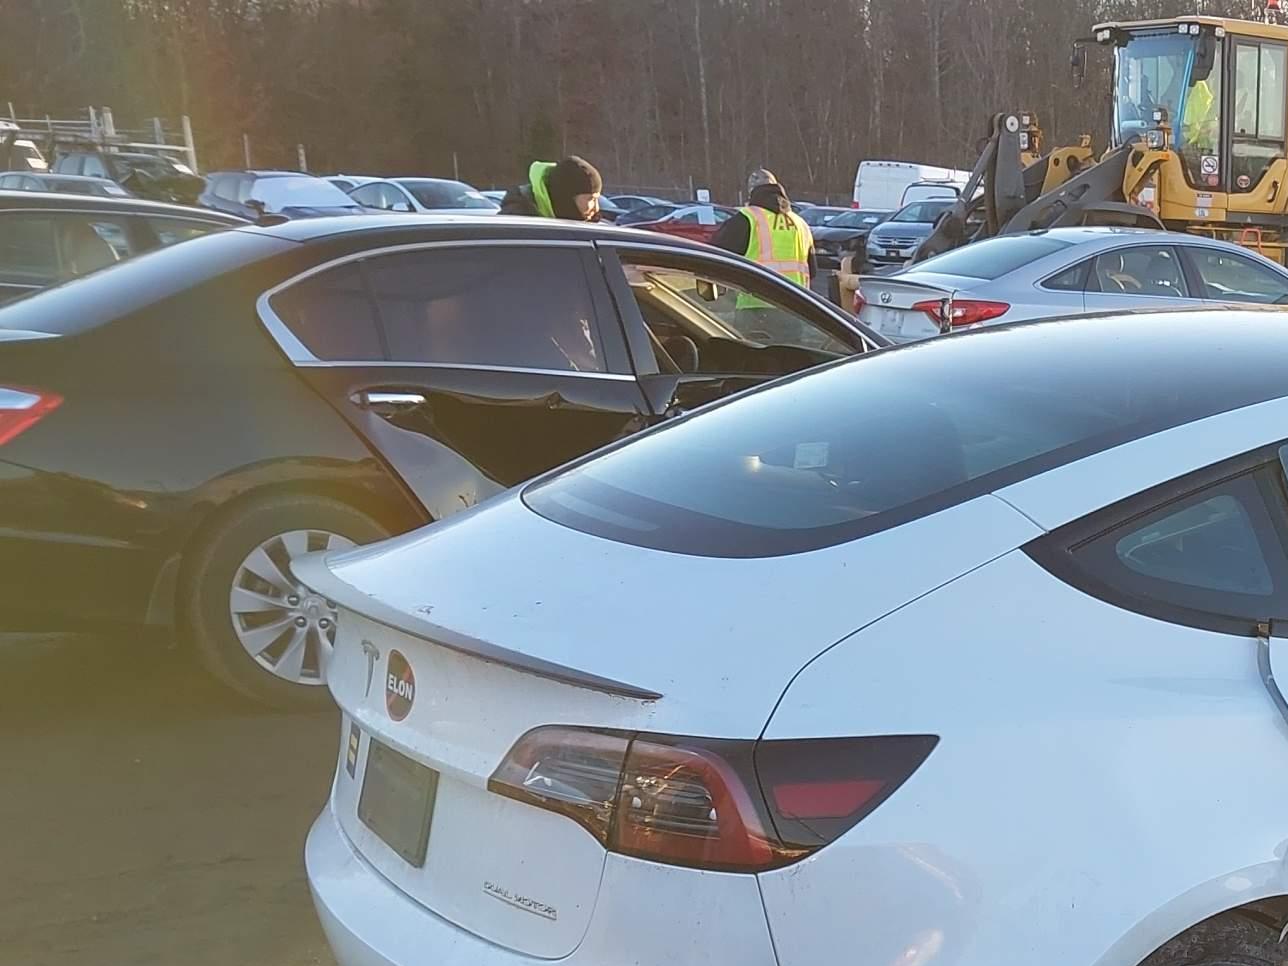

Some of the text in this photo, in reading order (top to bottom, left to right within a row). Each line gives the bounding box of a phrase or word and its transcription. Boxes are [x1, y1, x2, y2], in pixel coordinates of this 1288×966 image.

[388, 674, 413, 701] ELON
[483, 880, 558, 917] DUAL MOTOR
